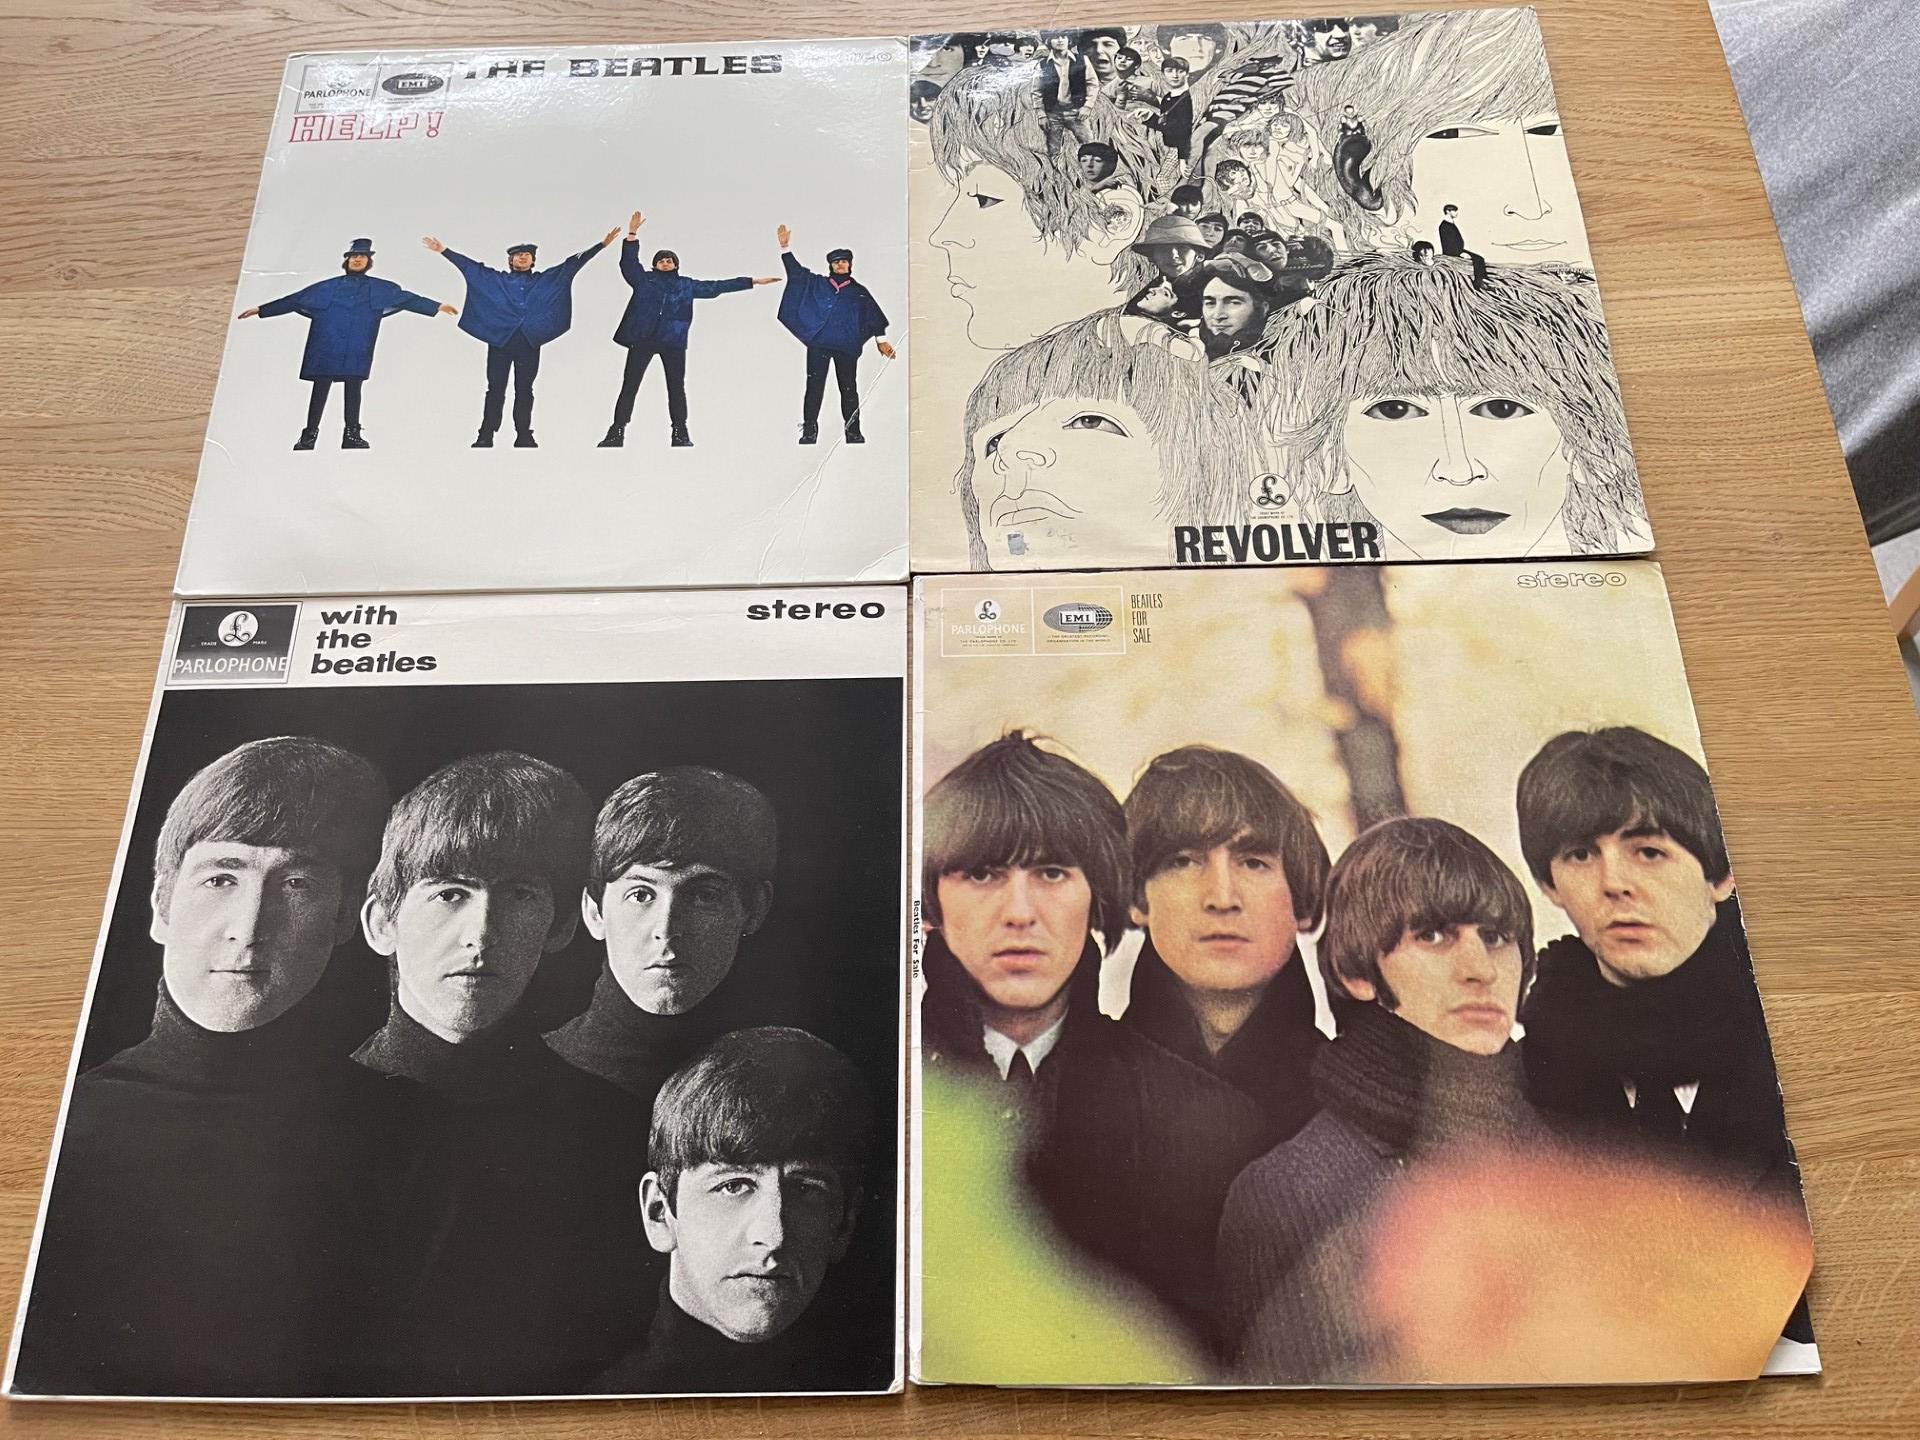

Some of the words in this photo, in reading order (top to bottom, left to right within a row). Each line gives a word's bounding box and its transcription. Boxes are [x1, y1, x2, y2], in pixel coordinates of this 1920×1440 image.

[568, 54, 783, 78] BEATLES
[303, 88, 372, 99] PARLOPHONE
[289, 111, 444, 143] HELP!
[1174, 521, 1381, 563] REVOLVER
[1517, 570, 1627, 589] stereo
[746, 599, 886, 620] stereo
[1131, 593, 1164, 609] BEATLES
[320, 604, 398, 626] with
[1065, 614, 1090, 623] EMI
[1132, 610, 1148, 626] FOR
[316, 629, 372, 649] the
[951, 623, 1026, 635] PARLOPHONE
[1133, 627, 1152, 643] SALE
[172, 655, 288, 675] PARLOPHONE
[310, 650, 438, 675] beatles
[912, 900, 920, 935] Beatles
[912, 959, 920, 979] Sale
